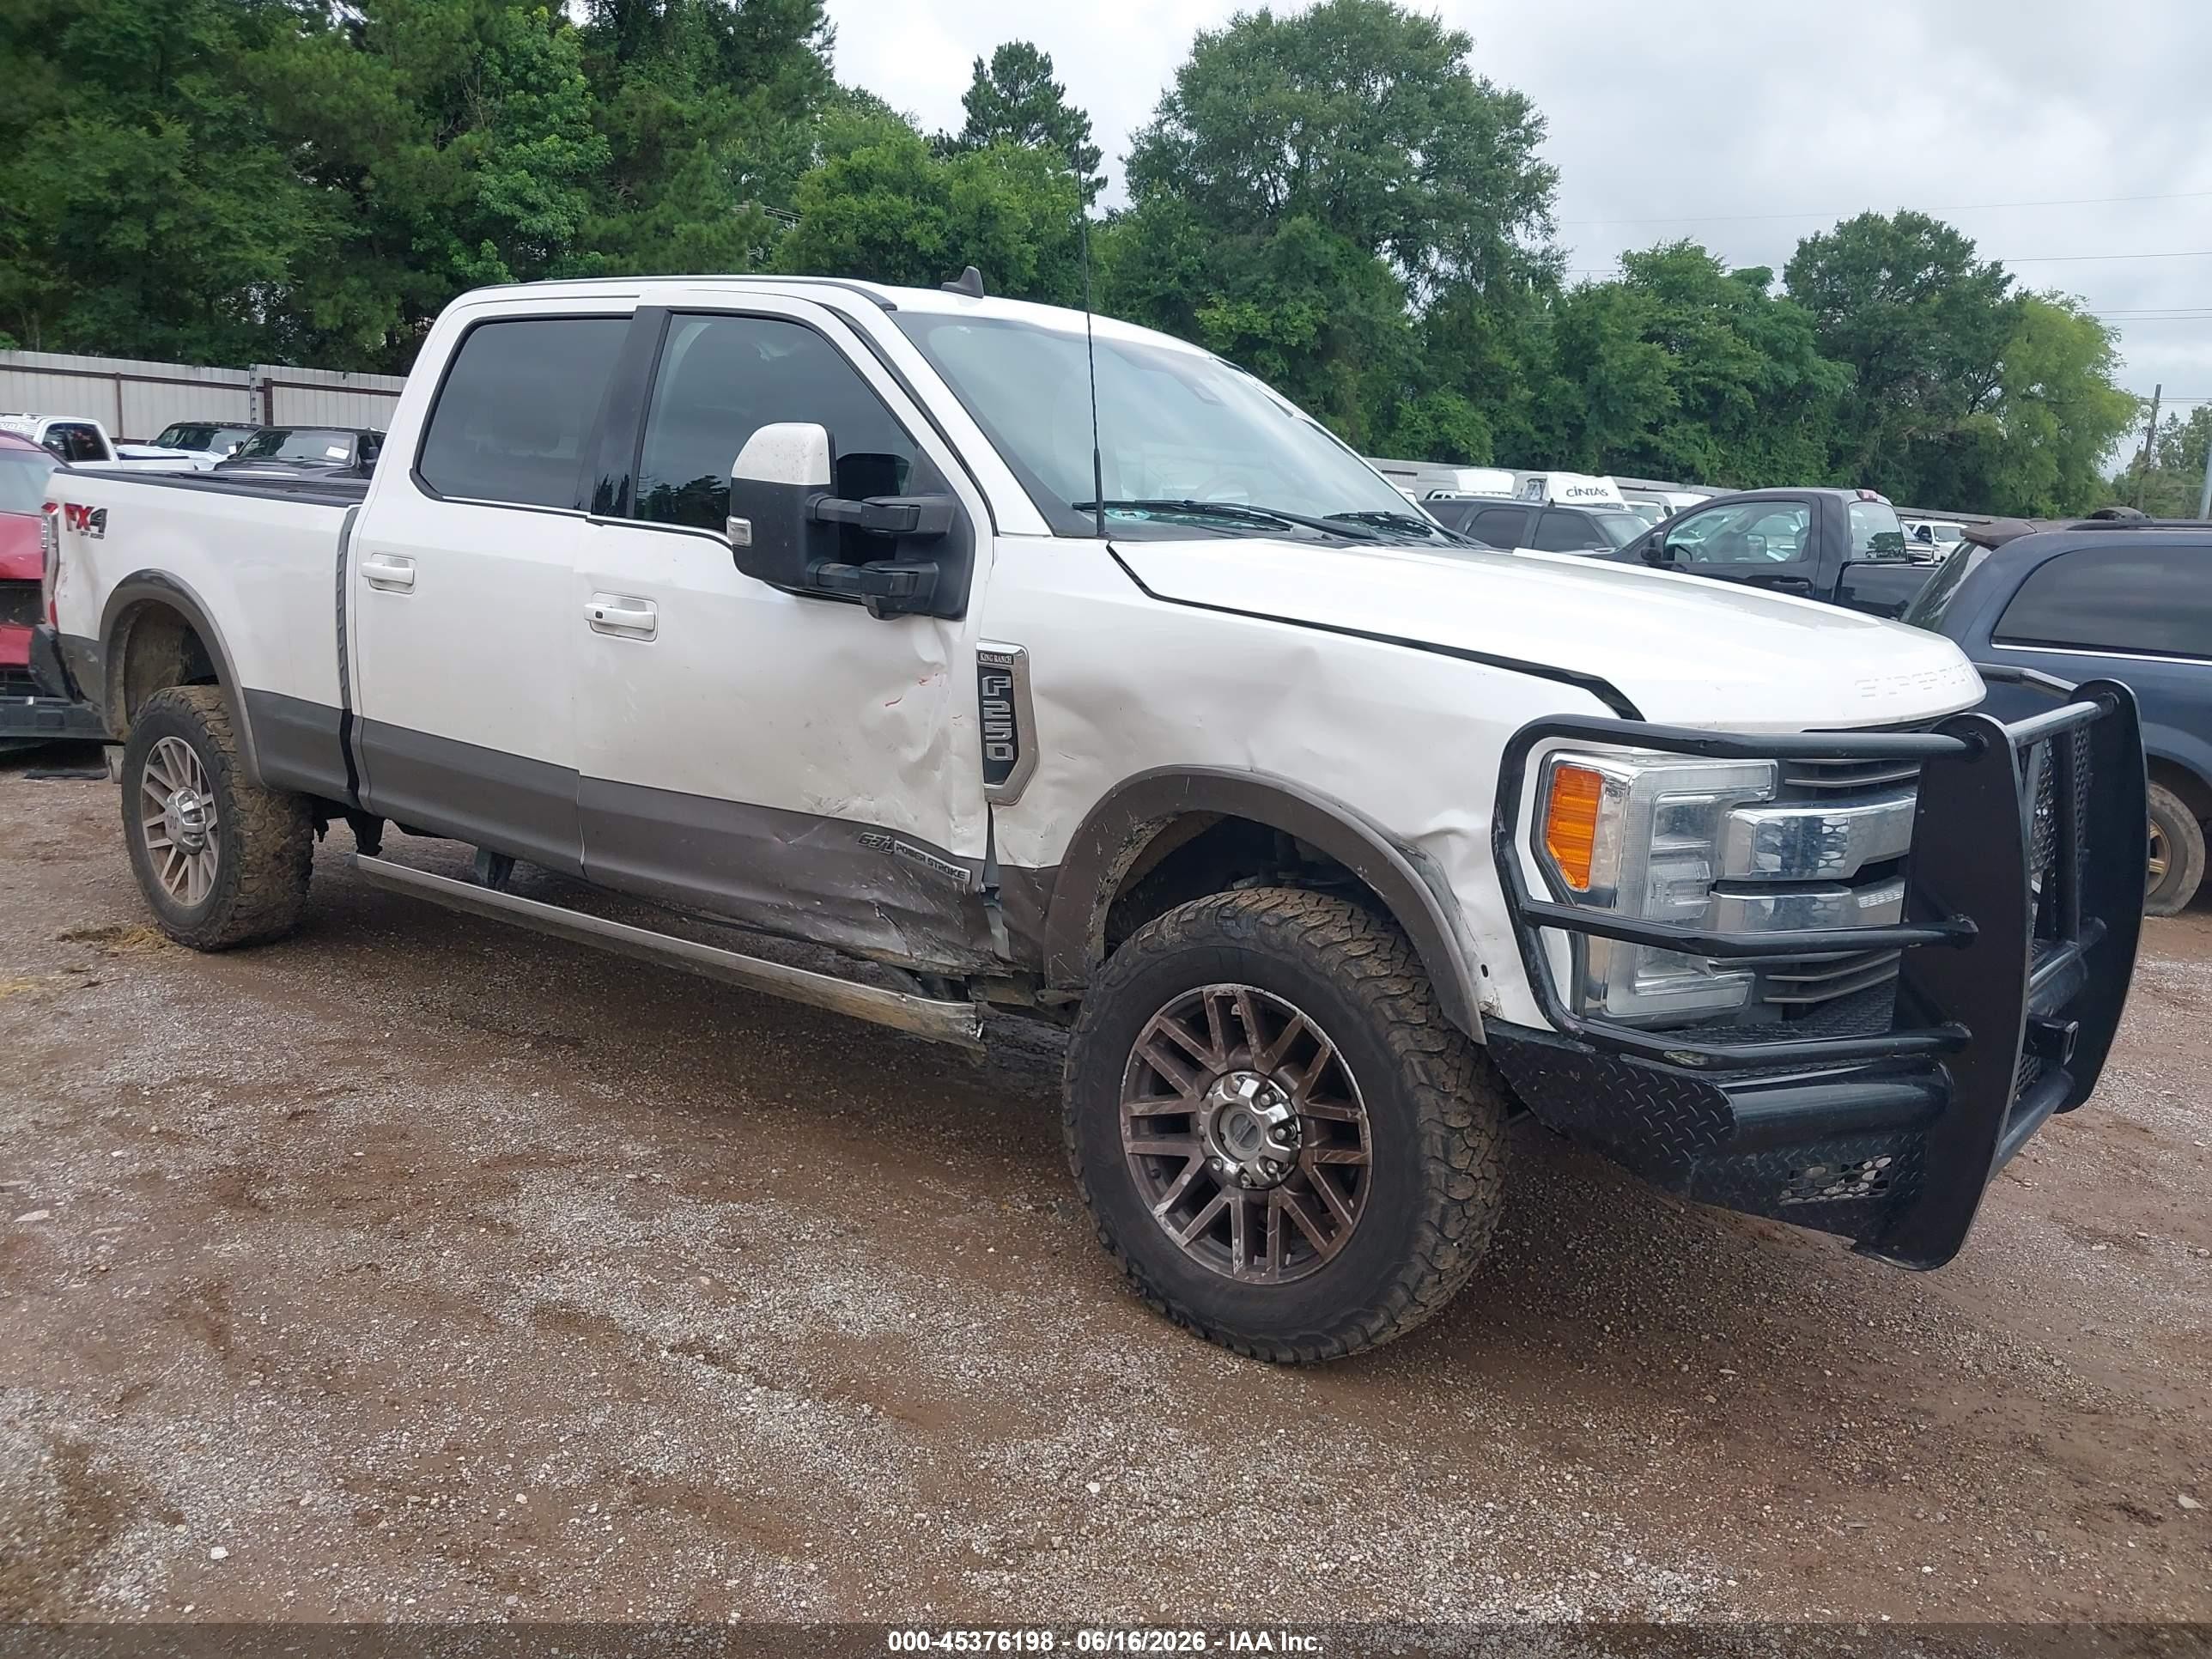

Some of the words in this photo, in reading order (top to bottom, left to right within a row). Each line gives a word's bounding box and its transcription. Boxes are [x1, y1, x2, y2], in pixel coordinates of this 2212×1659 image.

[64, 502, 108, 533] FX4
[980, 652, 994, 662] KING
[994, 653, 1012, 665] RANCH
[927, 857, 967, 880] STROKE
